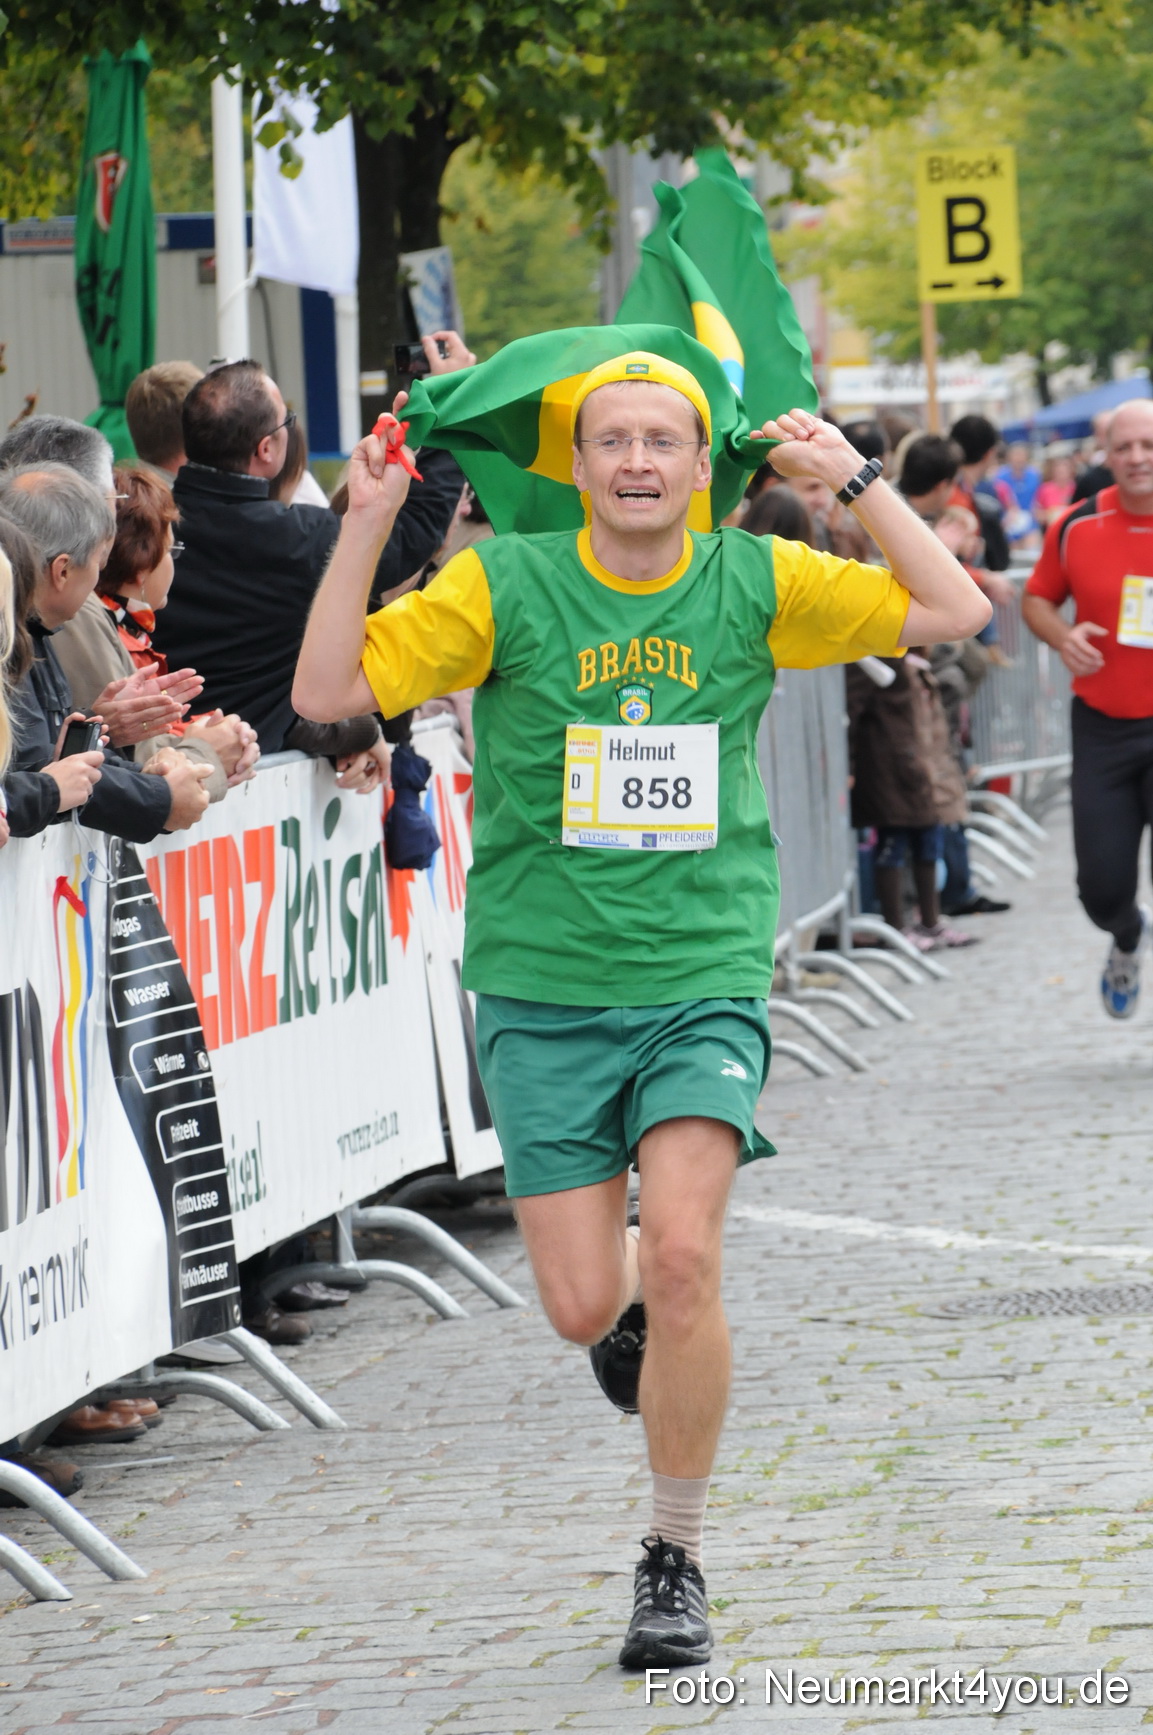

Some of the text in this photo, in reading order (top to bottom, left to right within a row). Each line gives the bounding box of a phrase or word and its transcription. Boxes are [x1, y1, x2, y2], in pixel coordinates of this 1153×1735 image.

[928, 154, 1003, 182] Block
[946, 197, 990, 263] B
[577, 636, 698, 691] BRASIL
[609, 738, 676, 761] Helmut
[571, 773, 581, 790] D
[621, 777, 692, 809] 858
[659, 832, 714, 843] PFLEIDERER
[279, 797, 388, 1024] Reisen
[124, 980, 170, 1006] Wasser
